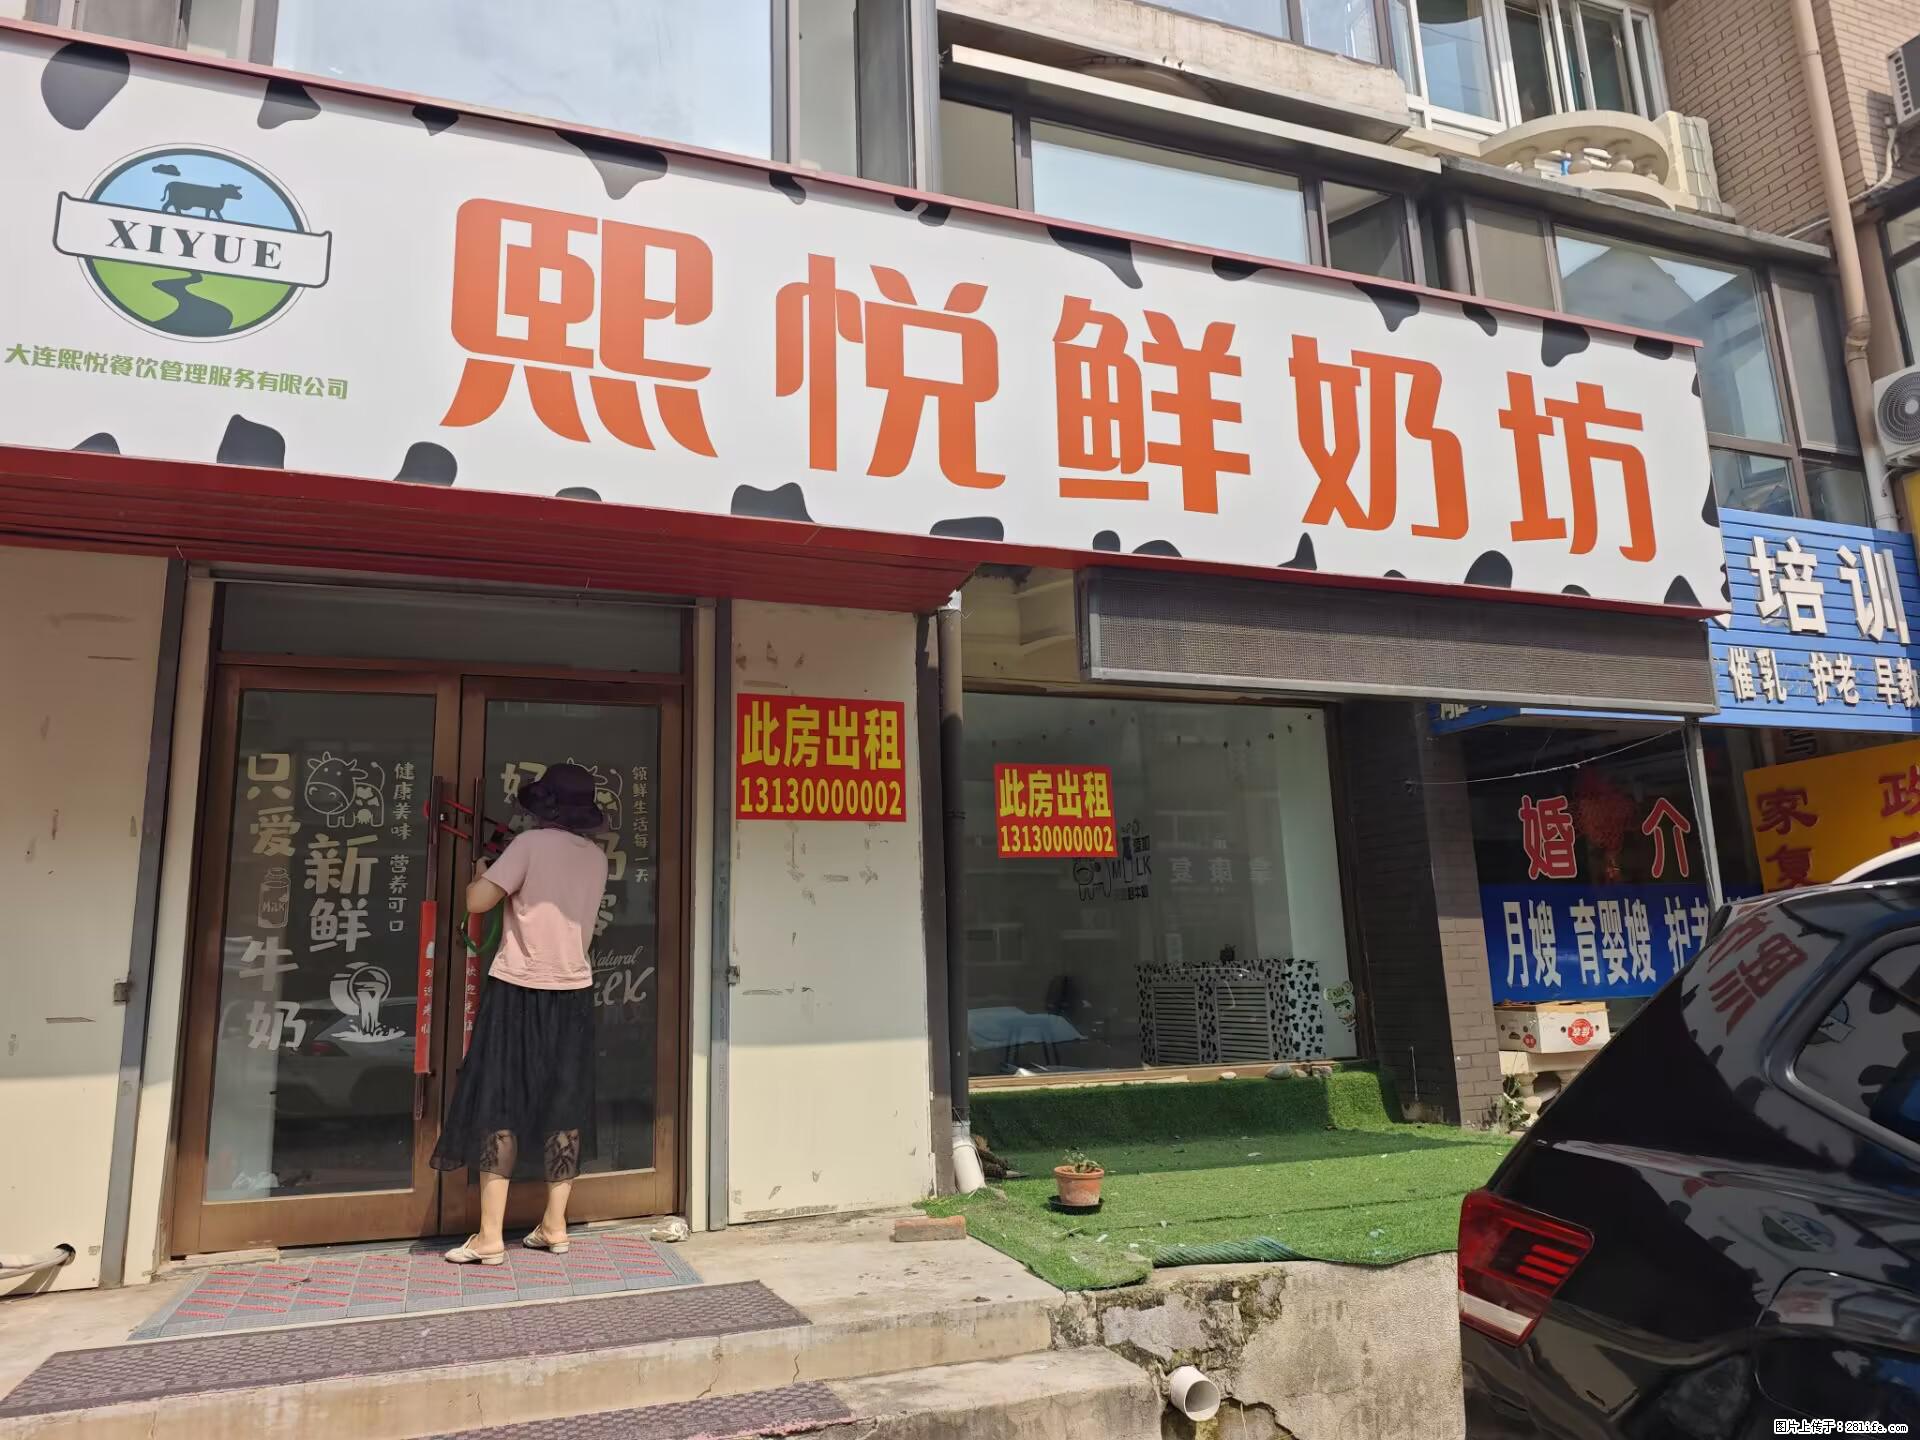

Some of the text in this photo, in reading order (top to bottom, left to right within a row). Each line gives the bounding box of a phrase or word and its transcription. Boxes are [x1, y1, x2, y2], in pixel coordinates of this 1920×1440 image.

[105, 217, 282, 270] XIYUE
[4, 343, 348, 400] 大连熙悦餐饮管理服务有限公司
[440, 197, 1657, 563] 熙悦鲜奶坊
[1748, 536, 1911, 645] 培训
[1728, 647, 1787, 703] 催乳
[1809, 652, 1860, 706] 护老
[741, 700, 902, 771] 此房出租
[740, 776, 902, 816] 13130000002
[999, 767, 1112, 818] 此房出租
[1000, 825, 1114, 853] 13130000002
[1518, 794, 1691, 880] 婚介
[303, 833, 379, 953] 新鲜
[1503, 899, 1562, 988] 月嫂
[1569, 898, 1656, 985] 育婴嫂
